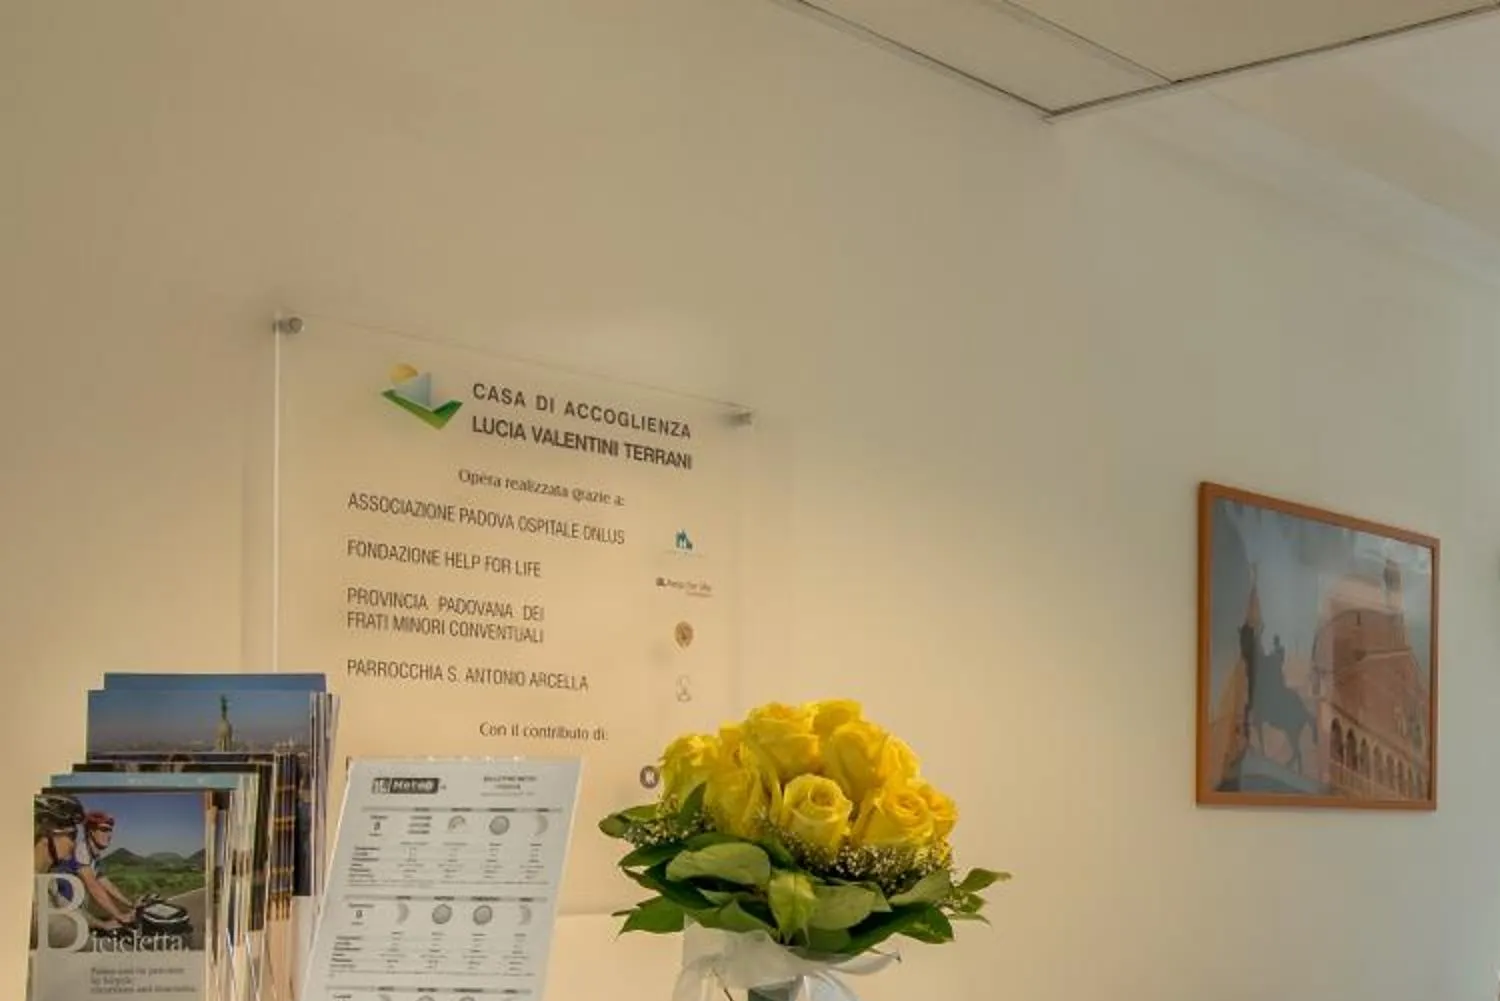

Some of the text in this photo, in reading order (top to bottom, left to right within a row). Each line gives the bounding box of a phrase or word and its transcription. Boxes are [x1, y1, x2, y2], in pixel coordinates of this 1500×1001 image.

[473, 383, 692, 439] CASA DI ACCOGLIENZA
[472, 415, 693, 471] LUCIA VALENTINI TERRANI
[458, 469, 501, 489] Opera
[505, 477, 569, 498] realizzata
[571, 487, 611, 504] grazie
[347, 492, 625, 545] ASSOCIAZIONE PADOVA OSPITALE ONLUS
[347, 539, 542, 578] FONDAZIONE HELP FOR LIFE
[347, 587, 544, 622] PROVINCIA PADOVANA DEI
[347, 611, 545, 644] FRATI MINORI CONVENTUALI
[347, 658, 443, 682] PARROCCHIA
[465, 667, 526, 687] ANTONIO
[529, 671, 590, 691] ARCELLA
[479, 721, 507, 738] Con
[512, 723, 520, 737] il
[523, 724, 589, 741] contributo
